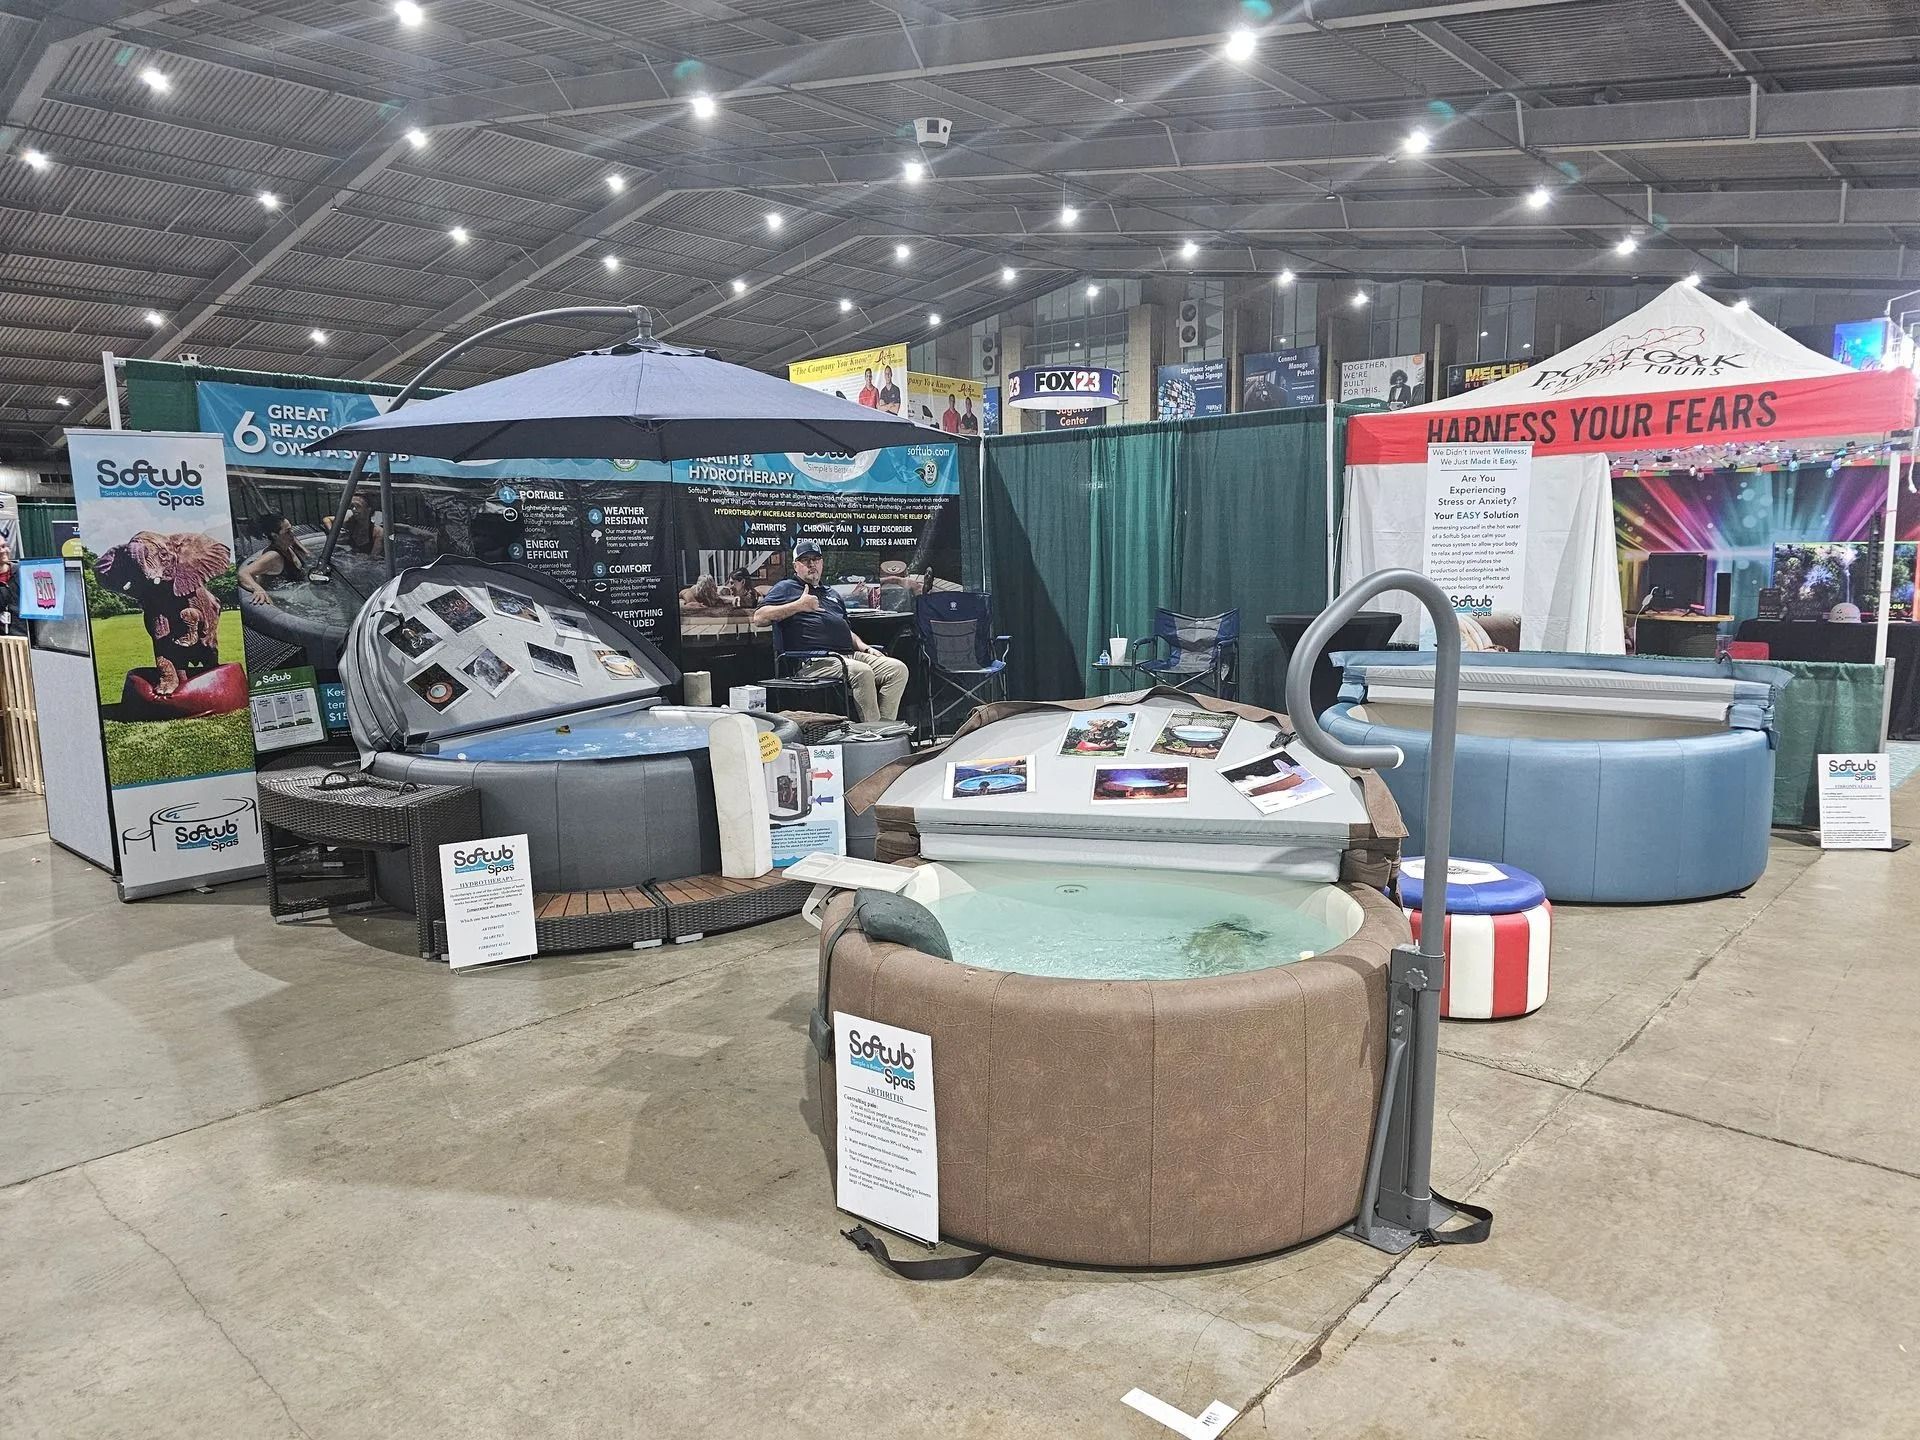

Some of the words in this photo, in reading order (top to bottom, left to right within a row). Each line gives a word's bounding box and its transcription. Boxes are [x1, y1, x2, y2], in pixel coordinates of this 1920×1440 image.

[808, 363, 835, 375] Company
[837, 360, 848, 369] You
[1181, 366, 1204, 374] Experience
[1343, 361, 1387, 371] TOGETHER,
[1645, 364, 1725, 377] TOURS
[1190, 373, 1205, 381] Digital
[1343, 371, 1368, 379] WE'RE
[1542, 362, 1632, 390] CANOPY
[1343, 380, 1364, 388] BUILT
[1343, 388, 1360, 396] FOR
[1361, 386, 1380, 395] THIS.
[267, 404, 329, 422] GREAT
[1427, 410, 1557, 444] HARNESS
[1570, 403, 1653, 442] YOUR
[1666, 391, 1777, 435] FEARS
[1060, 416, 1089, 426] Center
[233, 411, 267, 454] 6
[907, 445, 950, 457] softub.com
[1499, 458, 1518, 466] Easy.
[97, 459, 202, 487] Softub
[689, 465, 795, 485] HYDROTHERAPY
[519, 490, 564, 500] PORTABLE
[1449, 486, 1506, 495] Experiencing
[157, 491, 205, 511] Spas
[1478, 497, 1517, 507] Anxiety?
[603, 507, 645, 516] WEATHER
[714, 508, 762, 517] HYDROTHERAPY
[762, 509, 795, 517] INCREASES
[1434, 512, 1454, 520] Your
[1483, 511, 1519, 519] Solution
[604, 516, 649, 525] RESISTANT
[751, 523, 786, 532] ARTHRITIS
[803, 524, 835, 532] CHRONIC
[836, 524, 853, 532] PAIN
[881, 525, 913, 533] DISORDERS
[525, 540, 560, 549] ENERGY
[747, 537, 781, 545] DIABETES
[865, 538, 887, 546] STRESS
[893, 538, 917, 546] ANXIETY
[526, 550, 569, 559] EFFICIENT
[609, 564, 652, 574] COMFORT
[1450, 595, 1493, 608] Softub
[1472, 609, 1492, 618] Spas
[262, 673, 292, 684] Softub
[1829, 759, 1876, 772] Softub
[1854, 772, 1877, 783] Spas
[175, 819, 238, 843] Softub
[211, 838, 240, 852] Spas
[453, 844, 514, 867] Softub
[487, 864, 515, 876] Spas
[459, 876, 515, 888] HYDROTHERAPY
[849, 1030, 915, 1070] Softub
[884, 1068, 916, 1091] Spas
[866, 1086, 904, 1103] ARTHRITIS
[843, 1093, 867, 1107] Controlling
